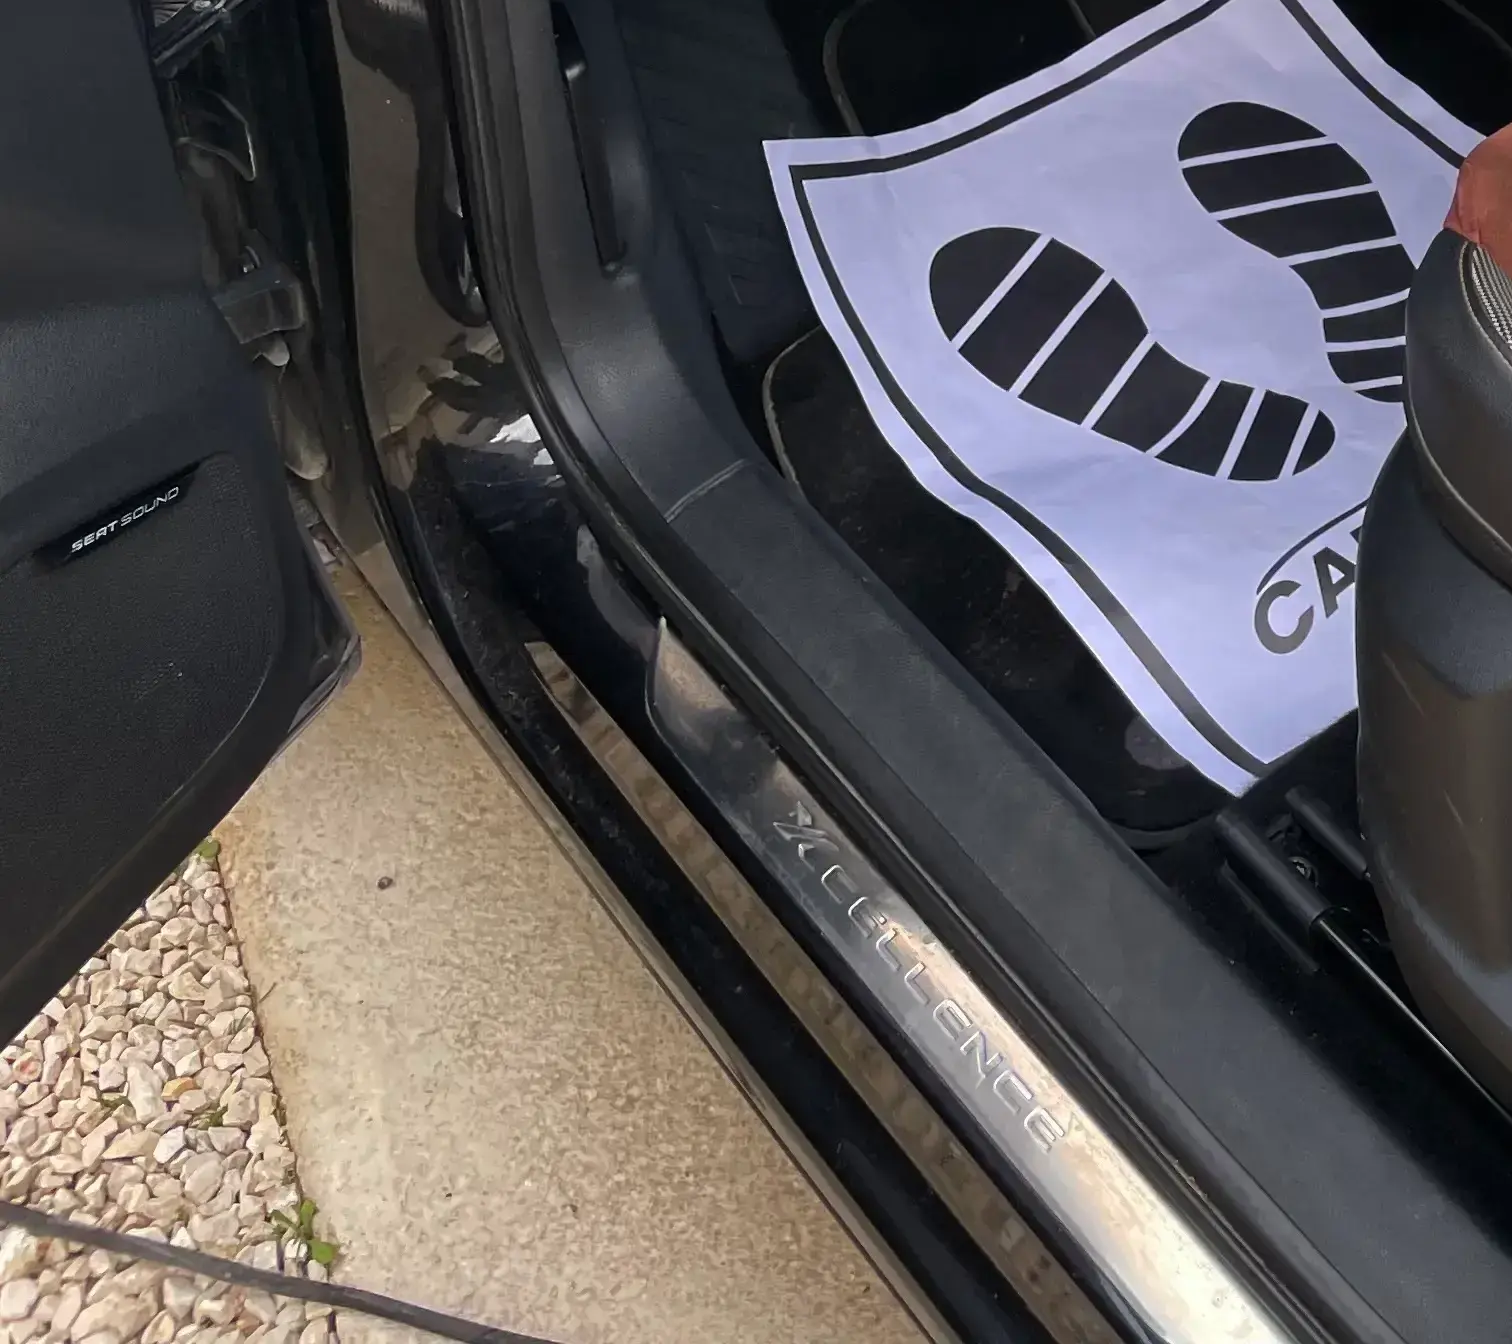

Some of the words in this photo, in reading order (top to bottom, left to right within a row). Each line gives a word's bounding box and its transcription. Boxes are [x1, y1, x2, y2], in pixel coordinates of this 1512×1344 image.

[71, 519, 119, 553] SEAT
[120, 486, 179, 527] SOUND
[1254, 524, 1363, 654] CA
